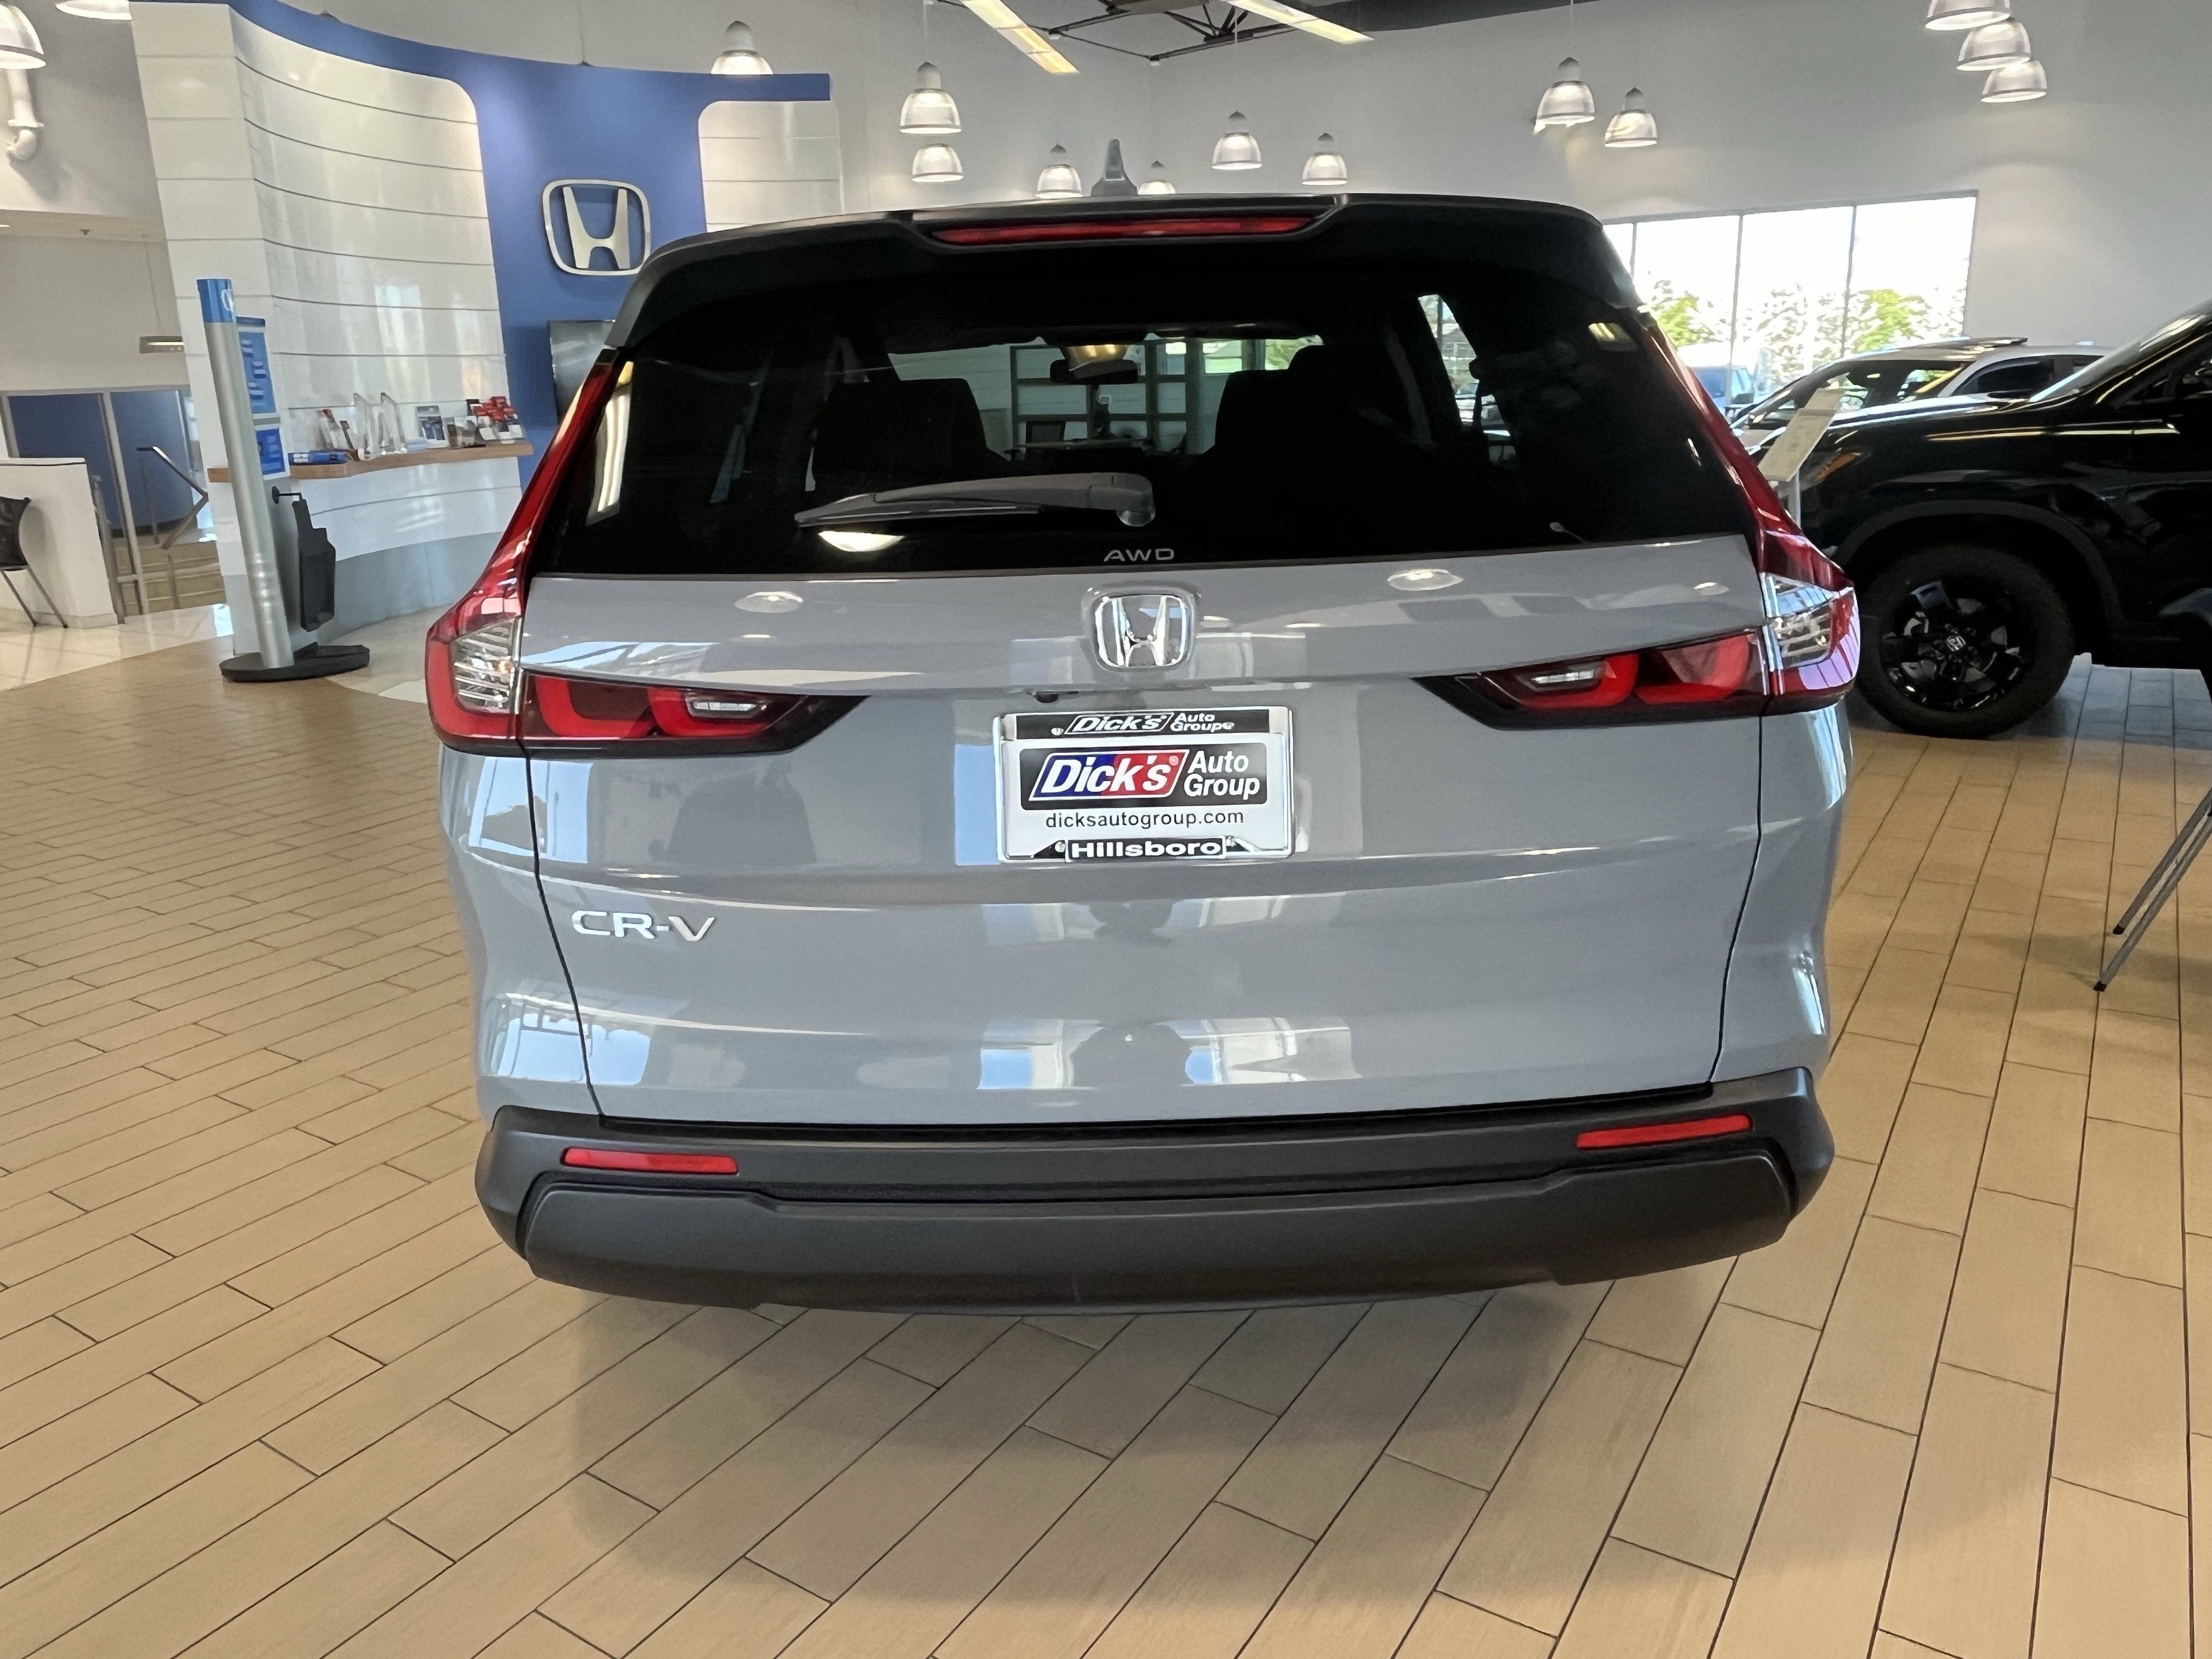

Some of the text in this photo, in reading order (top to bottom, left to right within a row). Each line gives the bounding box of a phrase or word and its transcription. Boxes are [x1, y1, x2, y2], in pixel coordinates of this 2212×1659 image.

[1103, 548, 1175, 562] AWD
[1073, 712, 1216, 732] Dick's Auto
[1170, 721, 1224, 733] Group
[1041, 750, 1249, 793] Dick's Auto
[1183, 774, 1260, 800] Group
[1046, 810, 1244, 830] dicksautogroup.com
[1071, 840, 1222, 859] Hillsboro
[572, 910, 715, 941] CR-V
